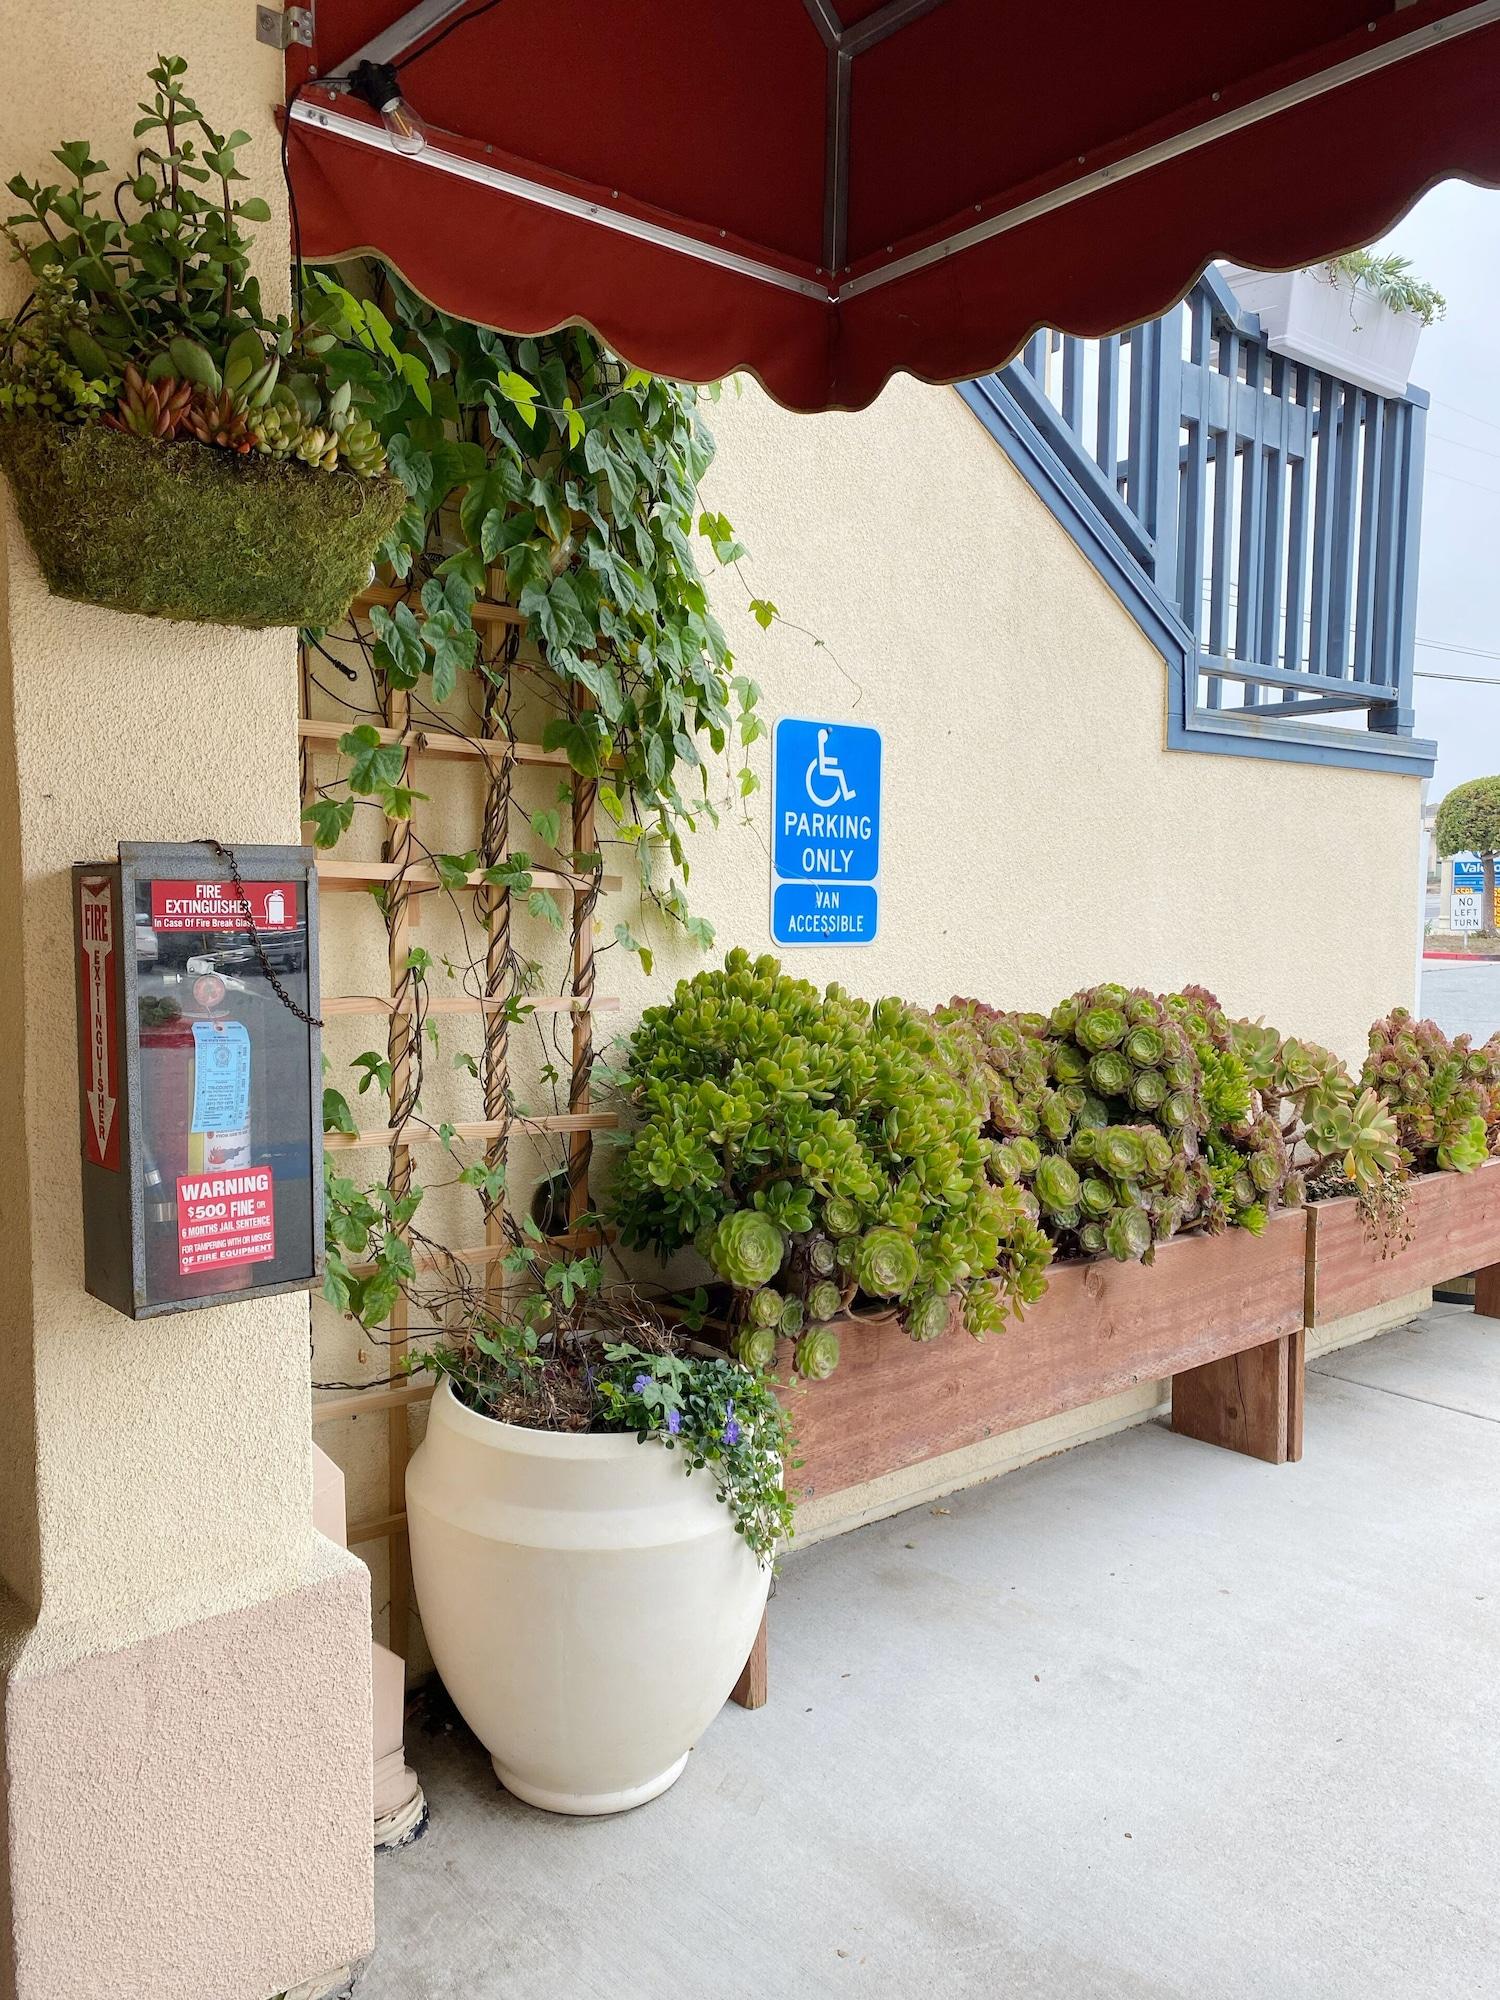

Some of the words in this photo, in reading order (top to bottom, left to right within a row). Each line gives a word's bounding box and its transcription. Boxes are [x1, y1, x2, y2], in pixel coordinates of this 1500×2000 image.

[784, 811, 872, 841] PARKING
[802, 848, 854, 873] ONLY
[196, 884, 222, 899] FIRE
[815, 891, 840, 909] VAN
[1458, 897, 1474, 906] NO
[165, 899, 252, 914] EXTINGUISHER
[1454, 908, 1478, 917] LEFT
[84, 903, 109, 943] FIRE
[154, 919, 162, 928] In
[163, 918, 183, 928] Case
[185, 918, 195, 928] Of
[196, 918, 210, 928] Fire
[212, 918, 234, 928] Break
[788, 914, 864, 933] ACCESSIBLE
[1454, 919, 1479, 927] TURN
[93, 950, 106, 1140] EXTINGUISHER
[181, 1174, 269, 1201] WARNING
[187, 1203, 227, 1219] $500
[230, 1199, 255, 1218] FINE
[256, 1200, 266, 1209] OR
[181, 1228, 187, 1238] 6
[188, 1223, 218, 1236] MONTHS
[219, 1221, 235, 1232] JAIL
[236, 1216, 271, 1229] SENTENCE
[181, 1245, 193, 1254] FOR
[194, 1239, 227, 1252] TAMPERING
[227, 1237, 242, 1247] WITH
[242, 1236, 251, 1244] OR
[250, 1232, 272, 1243] MISUSE
[182, 1256, 195, 1265] OF
[197, 1252, 218, 1262] FIRE
[219, 1243, 273, 1258] EQUIPMENT
